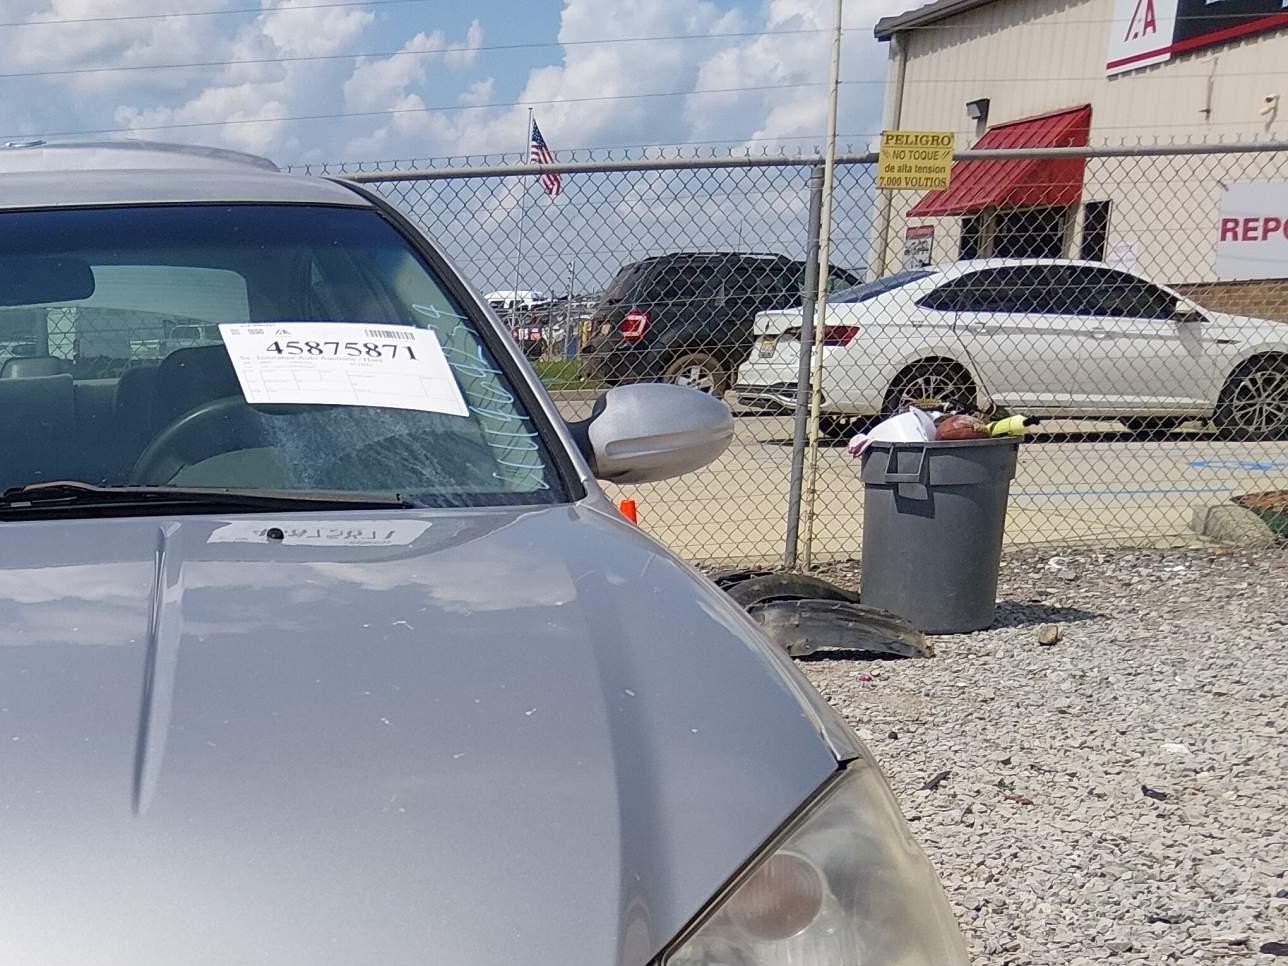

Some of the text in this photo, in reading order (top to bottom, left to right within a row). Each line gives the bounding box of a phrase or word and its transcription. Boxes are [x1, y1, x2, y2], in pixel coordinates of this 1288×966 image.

[884, 134, 952, 146] PELIGRO
[892, 150, 939, 161] NO TOQUE
[884, 162, 946, 174] de alta tension
[905, 176, 947, 187] VOLTIOS
[265, 340, 419, 361] 45875871
